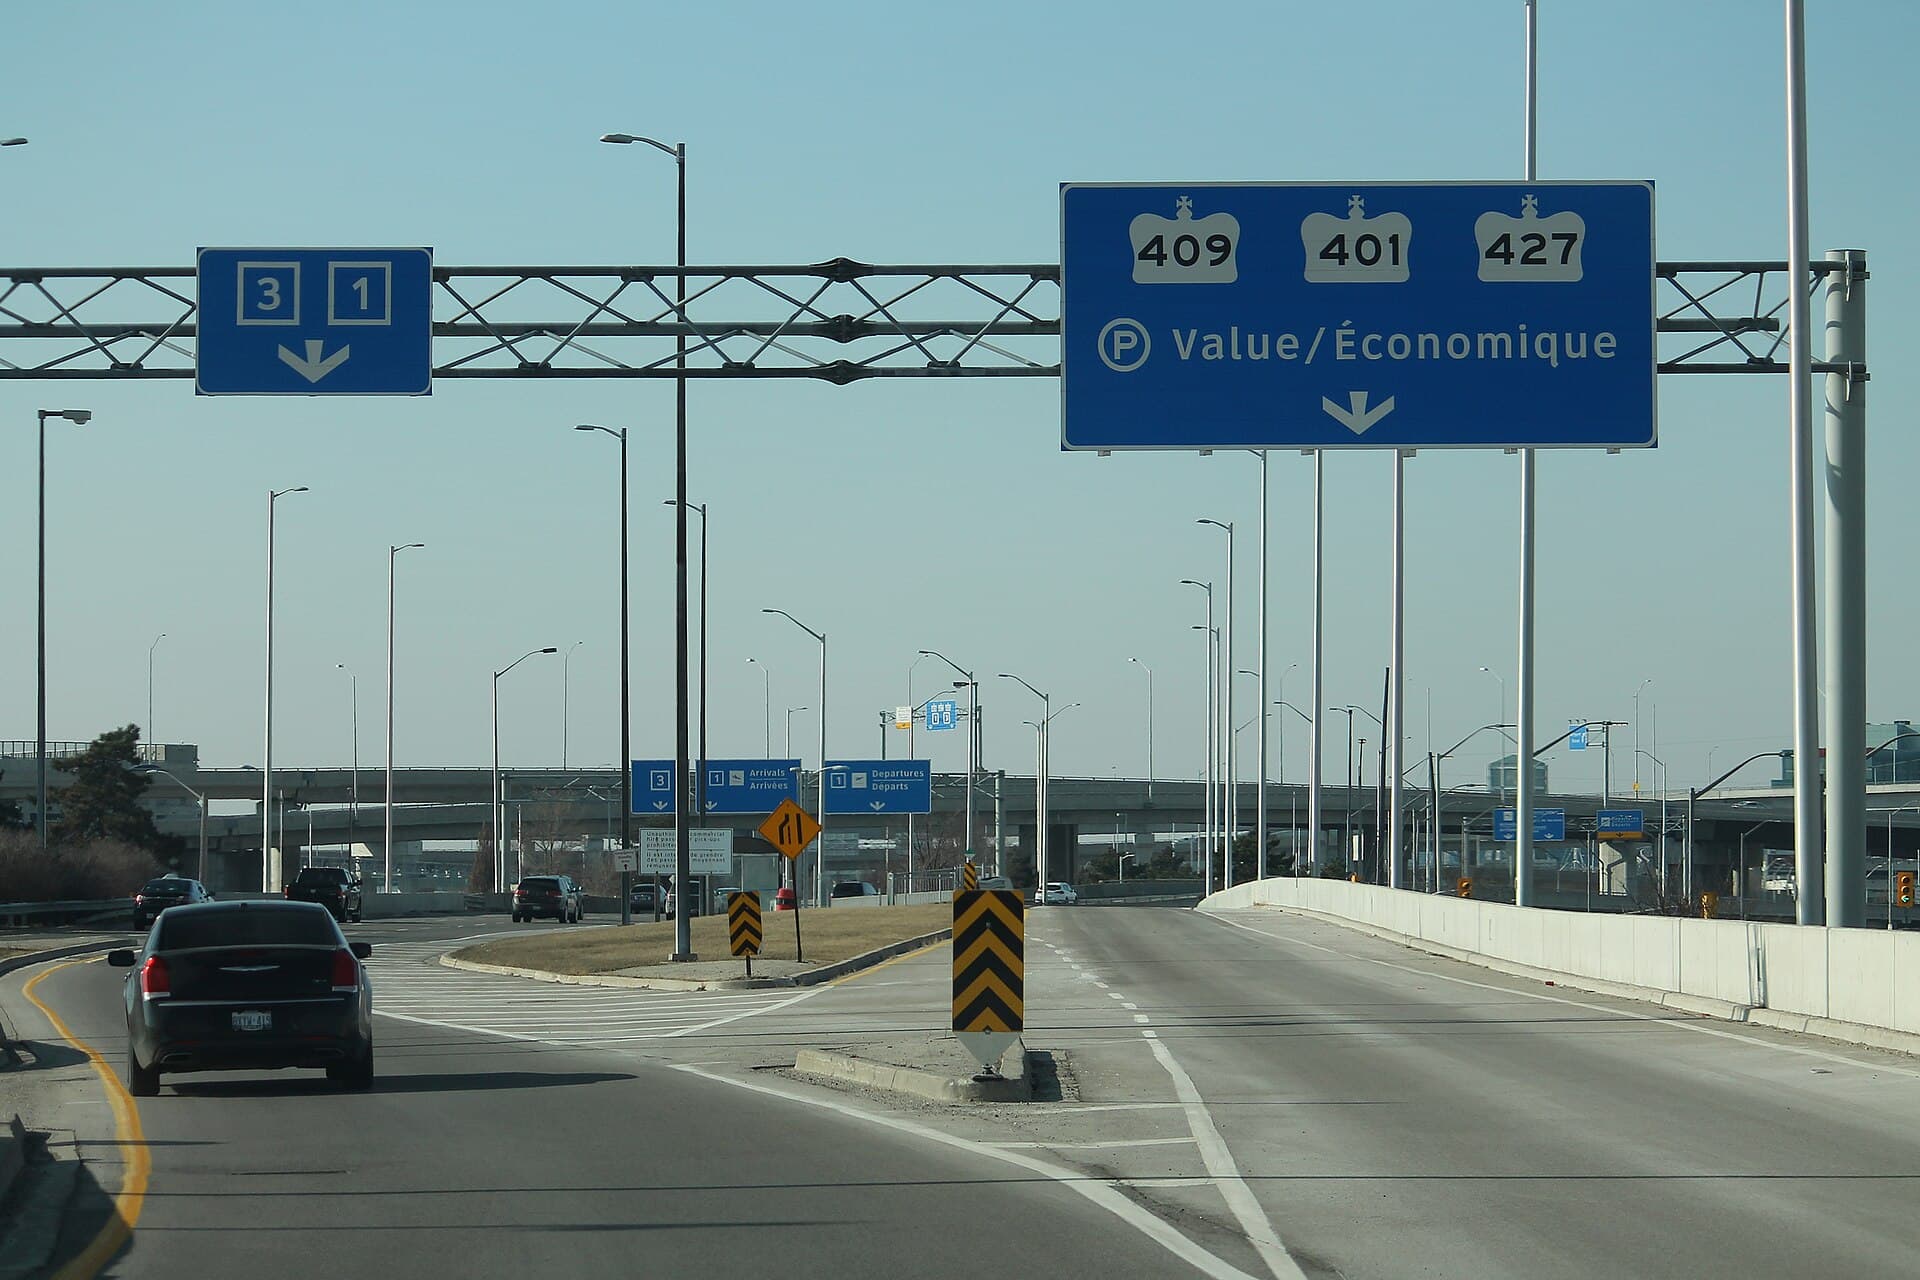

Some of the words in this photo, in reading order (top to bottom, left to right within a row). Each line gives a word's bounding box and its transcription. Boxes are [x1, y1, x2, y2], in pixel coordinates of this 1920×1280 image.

[1137, 234, 1232, 267] 409
[1319, 233, 1400, 266] 401
[1484, 232, 1578, 265] 427
[256, 276, 281, 311] 3
[352, 276, 368, 310] 1
[1113, 330, 1138, 360] P
[1172, 319, 1617, 368] Value/Économique
[714, 773, 720, 783] 1
[750, 768, 785, 777] Arrivals
[871, 769, 924, 779] Departures
[656, 774, 665, 786] 3
[871, 780, 909, 792] Départs
